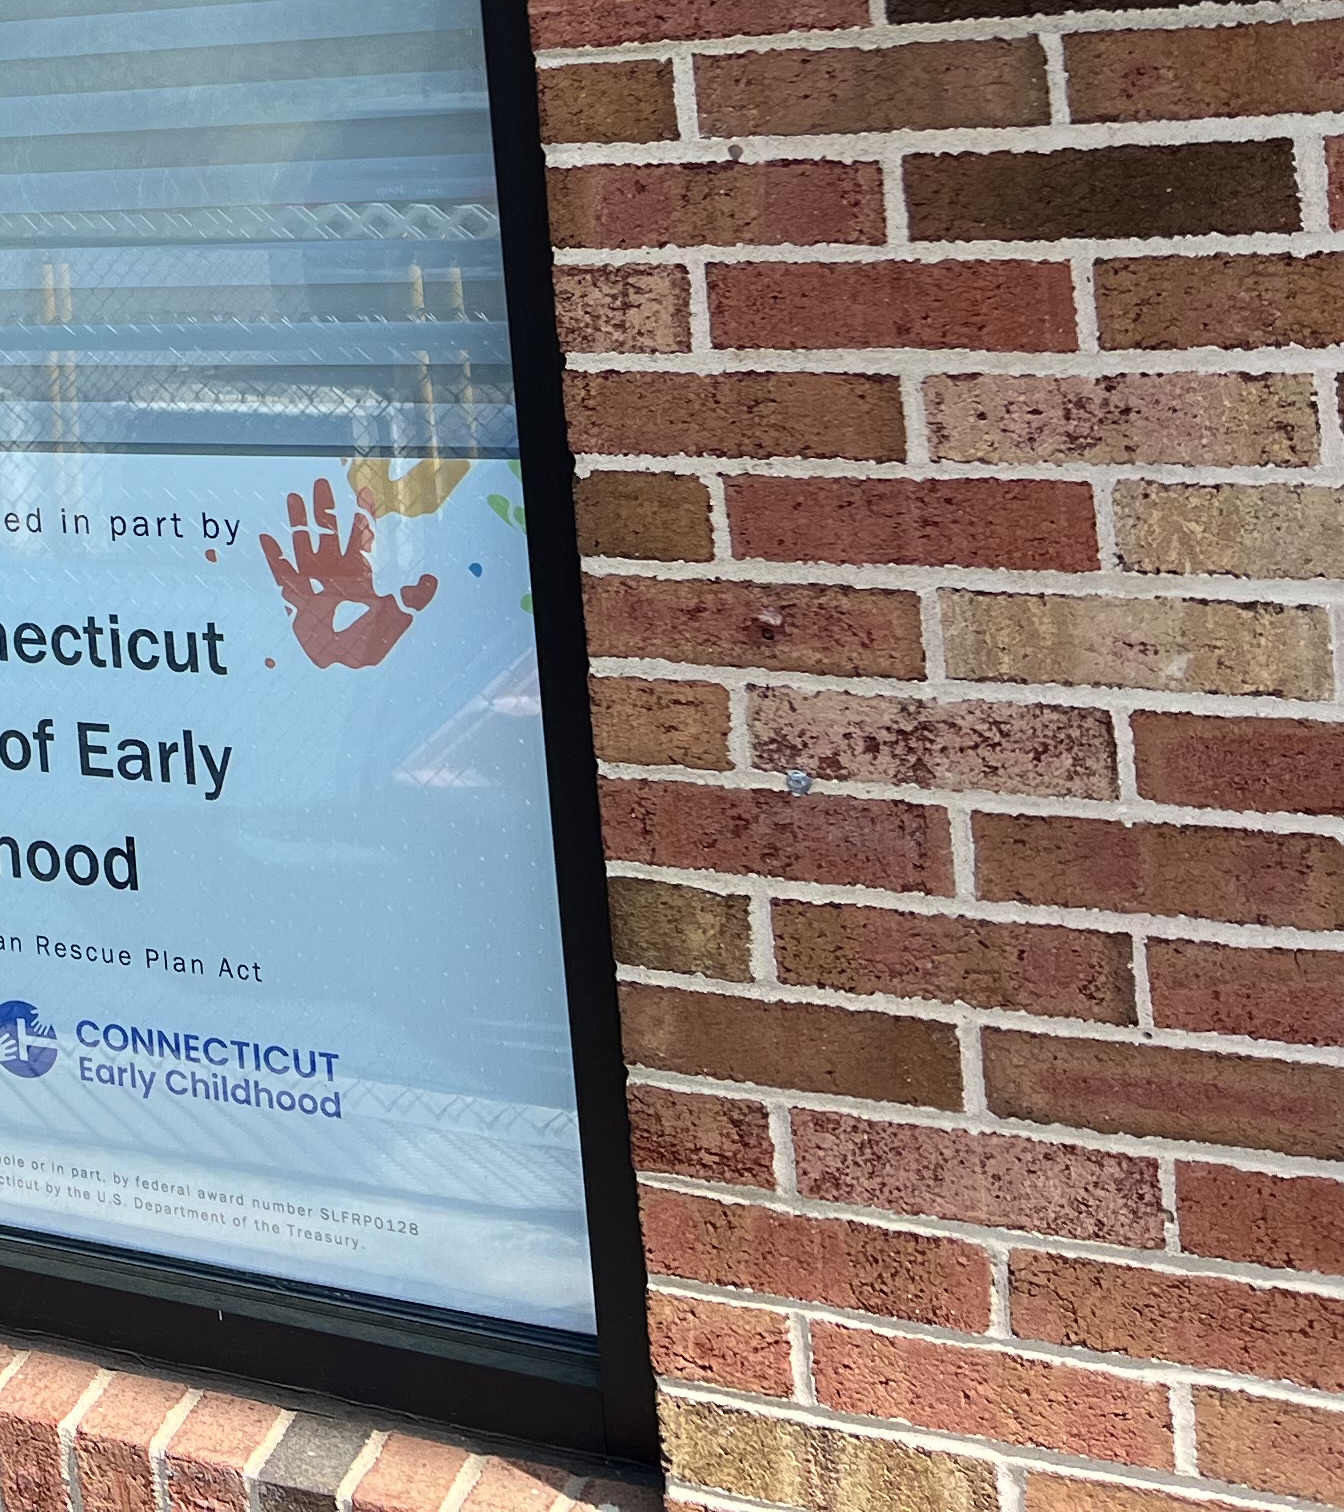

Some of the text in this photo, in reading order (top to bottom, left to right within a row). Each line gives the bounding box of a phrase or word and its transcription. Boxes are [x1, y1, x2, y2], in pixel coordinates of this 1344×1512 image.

[60, 507, 91, 536] in
[109, 511, 185, 543] part
[202, 511, 242, 547] by
[76, 720, 233, 802] Early
[35, 934, 132, 968] Rescue
[145, 947, 205, 977] Plan
[218, 956, 264, 985] Act
[75, 1018, 341, 1084] CONNECTICUT
[78, 1055, 344, 1121] Early Childhood
[30, 1159, 47, 1173] or
[51, 1161, 65, 1176] in
[113, 1171, 130, 1190] by
[134, 1174, 192, 1198] federal
[197, 1188, 245, 1208] award
[251, 1196, 314, 1219] number
[45, 1178, 62, 1198] by
[67, 1186, 91, 1202] the
[96, 1190, 129, 1209] U.S.
[134, 1196, 227, 1226] Department
[232, 1215, 249, 1230] of
[254, 1217, 281, 1235] the
[286, 1224, 367, 1251] Treasury.
